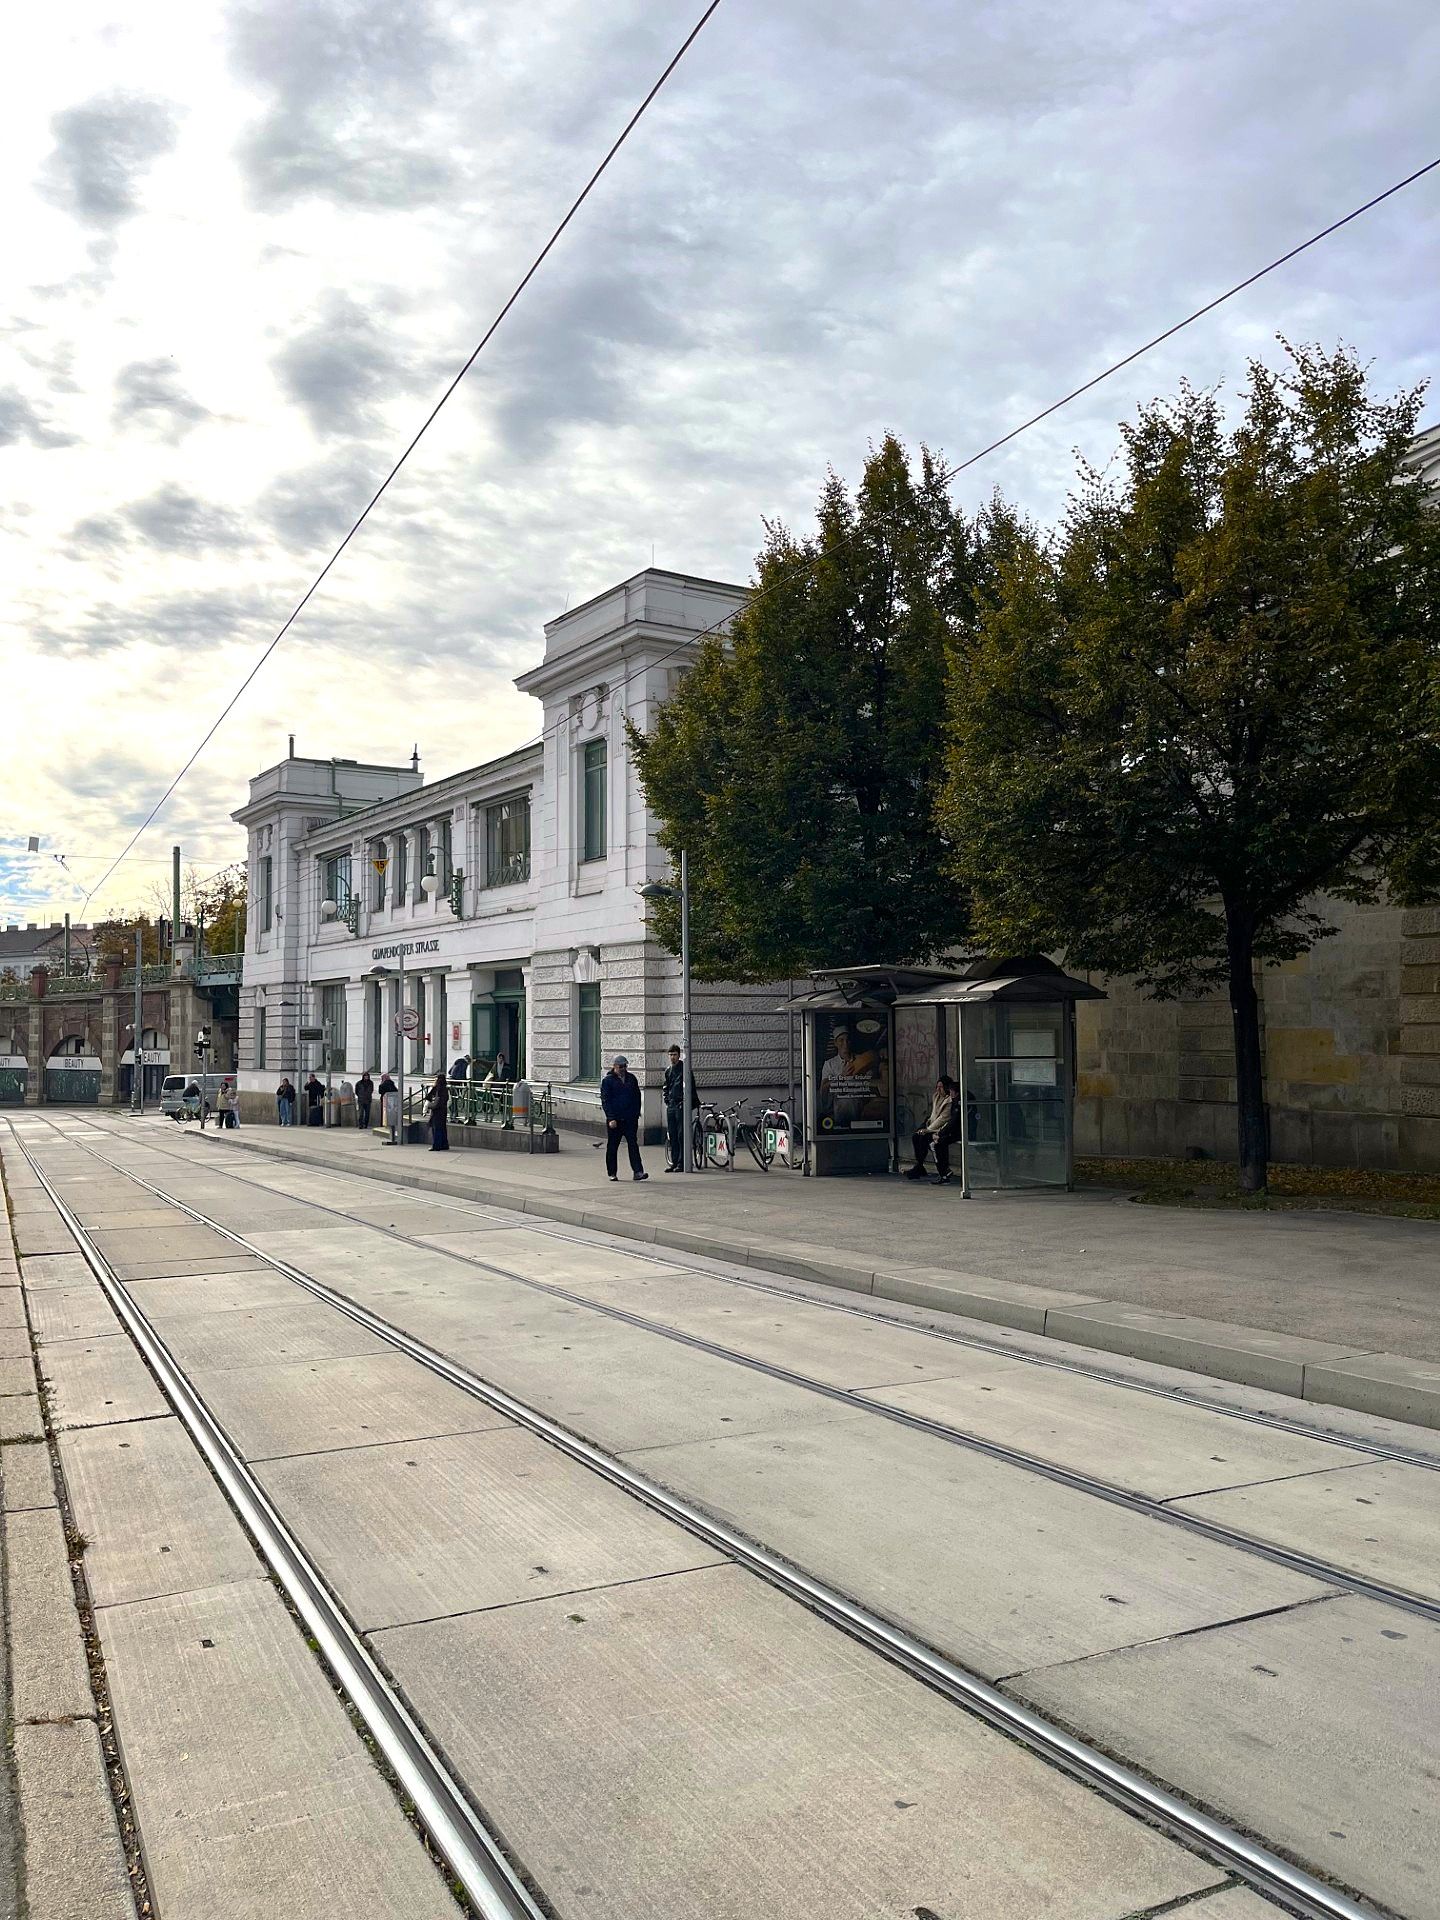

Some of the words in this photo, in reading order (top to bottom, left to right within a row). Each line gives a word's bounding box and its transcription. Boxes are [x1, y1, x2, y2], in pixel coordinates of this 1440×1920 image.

[375, 860, 385, 869] 15
[415, 939, 440, 954] STRASSE
[64, 1058, 84, 1068] BEAUTY
[708, 1135, 715, 1153] P
[767, 1131, 774, 1149] P
